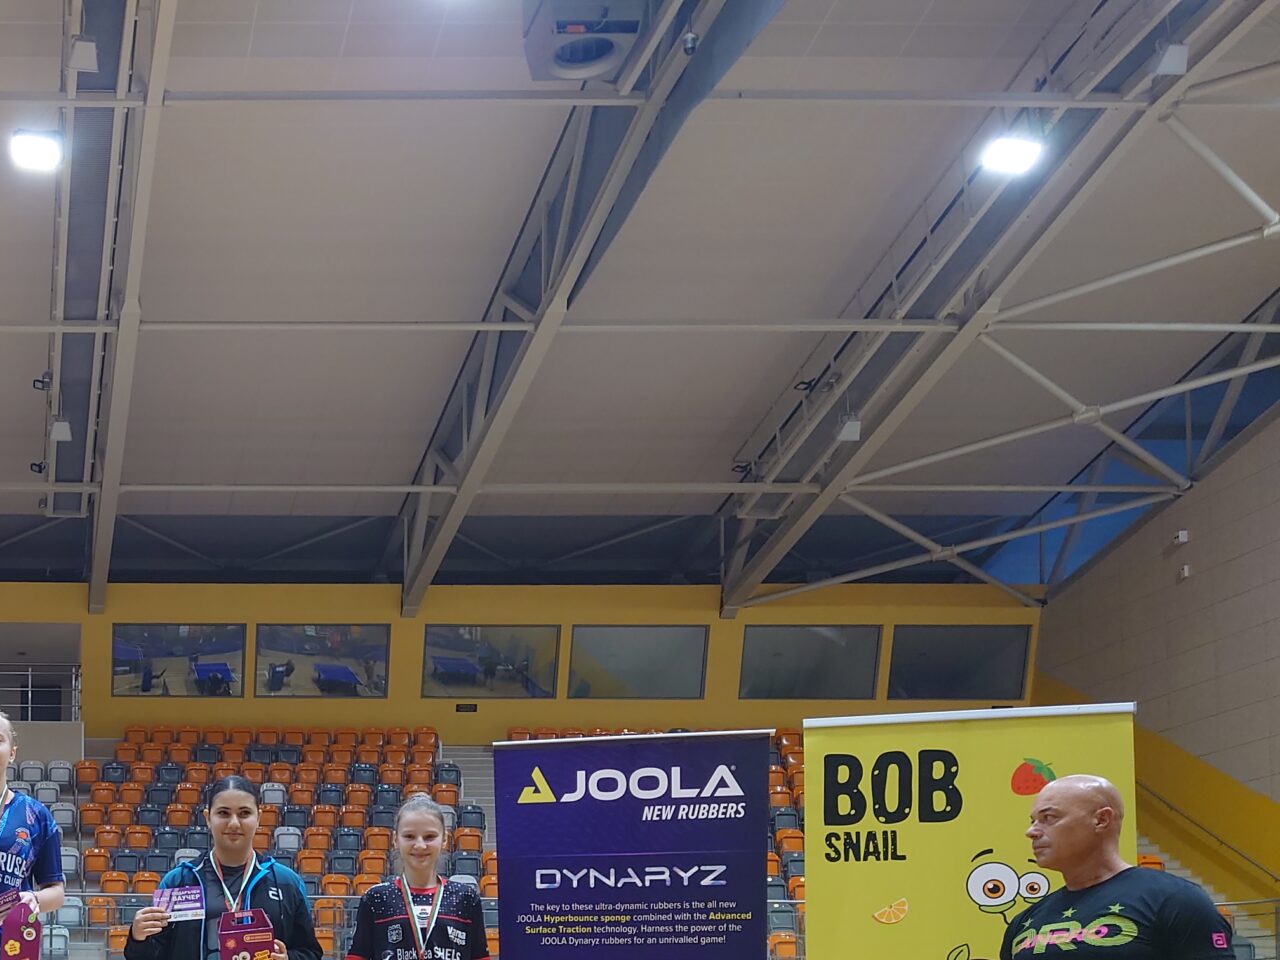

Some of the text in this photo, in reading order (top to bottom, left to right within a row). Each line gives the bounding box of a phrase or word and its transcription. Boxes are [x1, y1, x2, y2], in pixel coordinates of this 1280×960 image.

[560, 765, 745, 802] JOOLA
[824, 749, 963, 826] BOB
[642, 803, 745, 821] NEW RUBBERS
[824, 830, 906, 863] SNAIL
[4, 874, 20, 887] CLUB
[535, 865, 727, 889] DYNARYZ
[531, 903, 545, 911] The
[547, 903, 560, 912] key
[572, 902, 593, 911] these
[595, 902, 648, 912] ultra-dynamic
[651, 901, 681, 909] rubbers
[692, 901, 705, 909] the
[707, 900, 717, 908] all
[517, 911, 751, 924] JOOLA Hyperbounce sponge combined with the Advanced
[525, 923, 742, 934] Surface Traction technology. Harness the power the
[540, 935, 726, 946] JOOLA Dynaryz rubbers for unrivalled game!
[397, 948, 417, 960] Black
